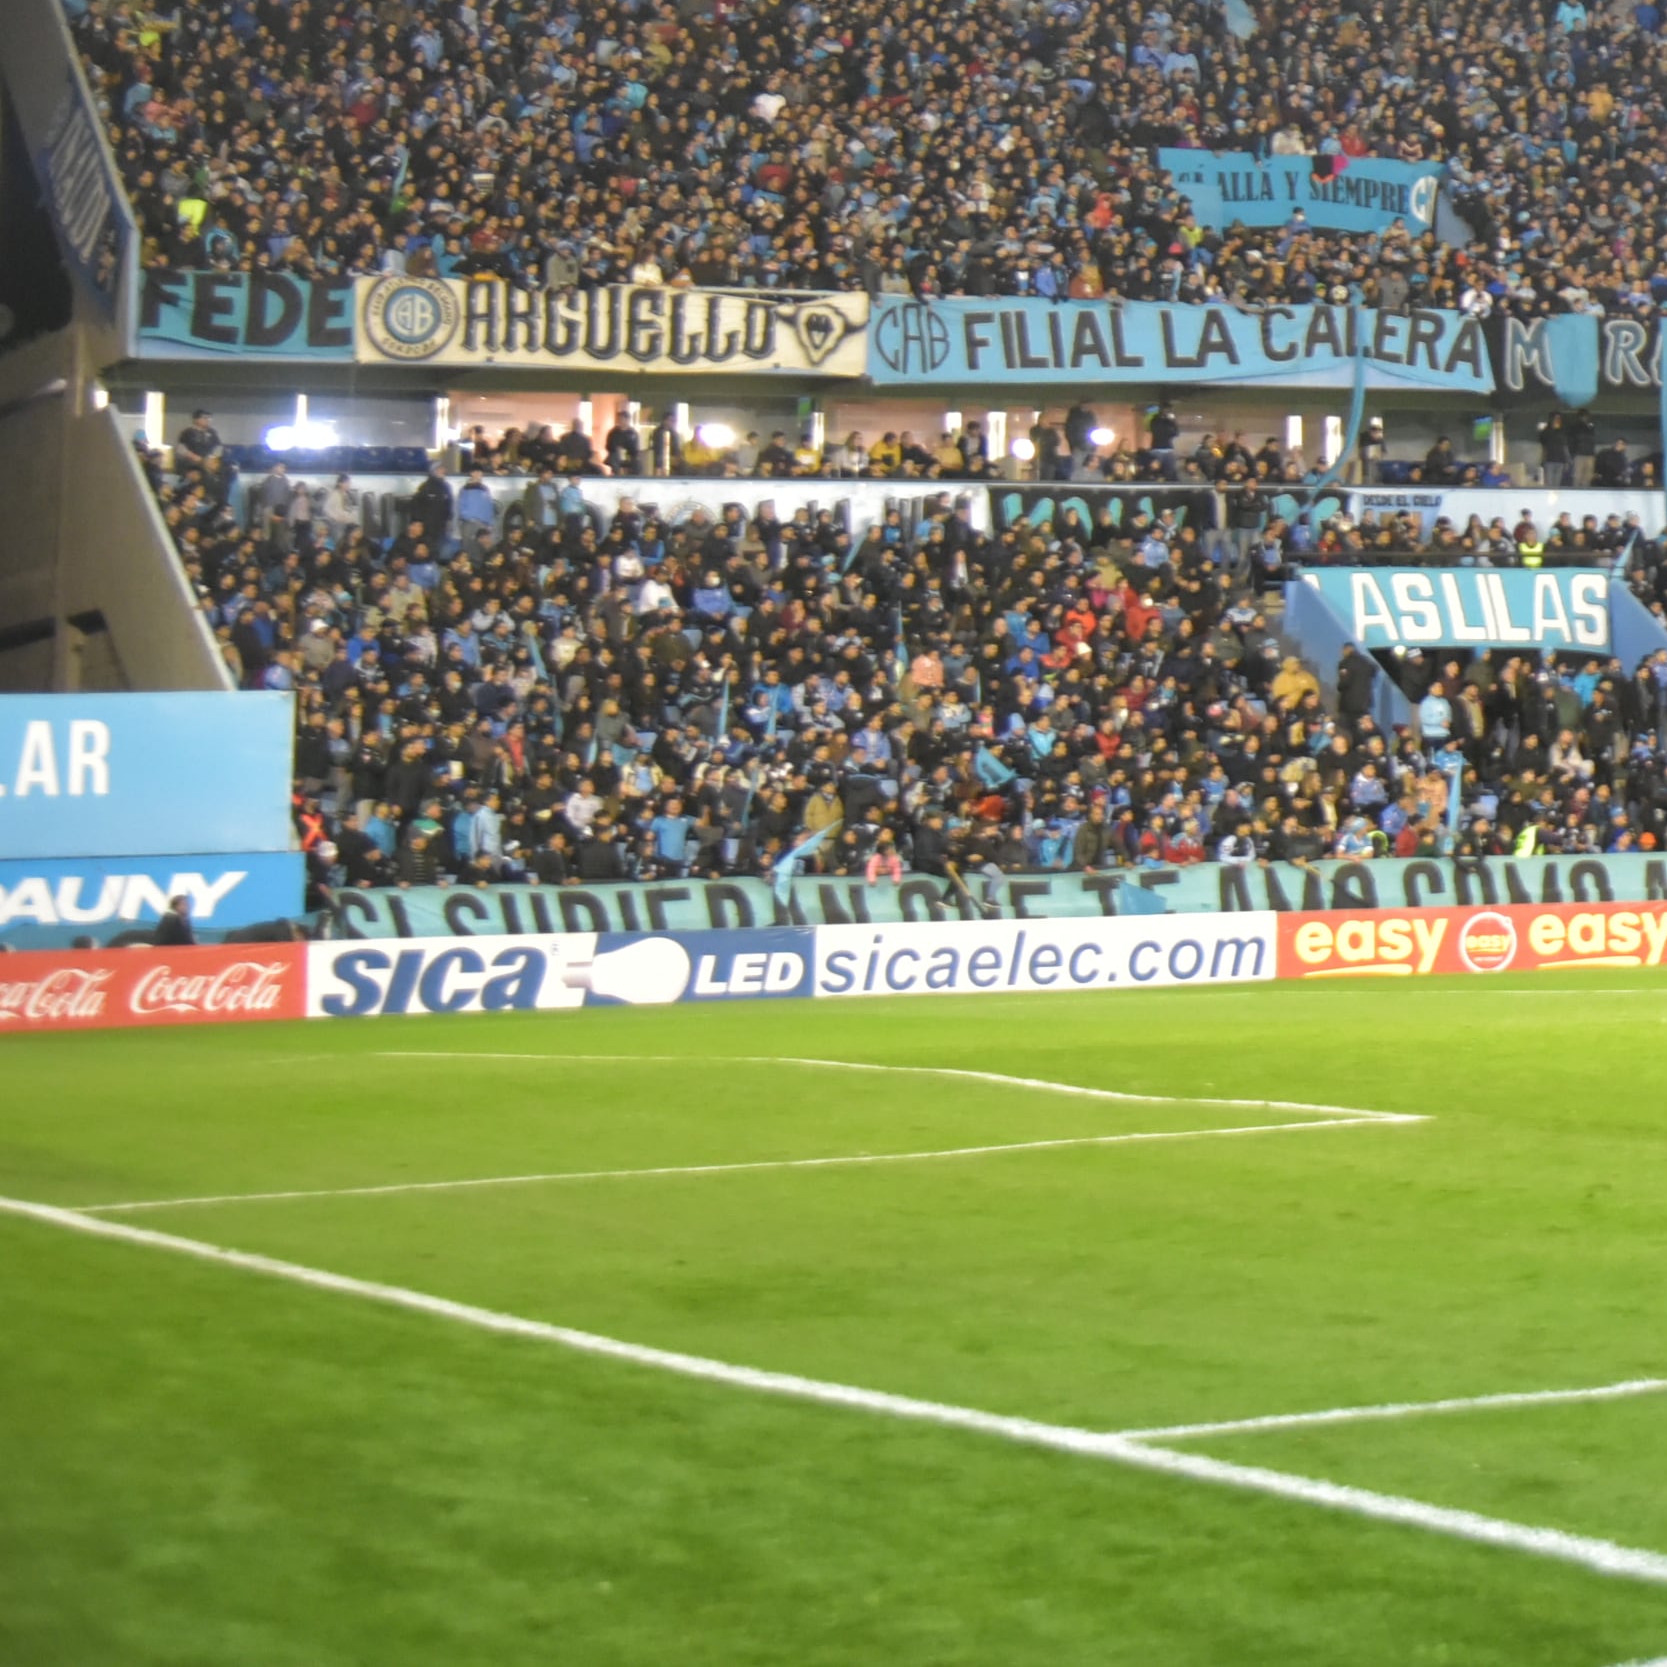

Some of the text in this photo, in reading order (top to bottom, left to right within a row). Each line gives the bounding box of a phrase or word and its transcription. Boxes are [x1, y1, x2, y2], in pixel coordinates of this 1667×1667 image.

[1284, 170, 1300, 201] Y
[141, 270, 353, 348] FEDE
[462, 279, 778, 365] ARGUELLO
[963, 308, 1144, 370] FILIAL
[1160, 308, 1241, 368] LA
[1260, 305, 1484, 379] CALERA
[0, 871, 249, 925] AUNY
[819, 929, 1268, 994] sicaelec.com
[1294, 916, 1449, 975] easy
[1465, 933, 1513, 952] easy
[693, 951, 805, 995] LED
